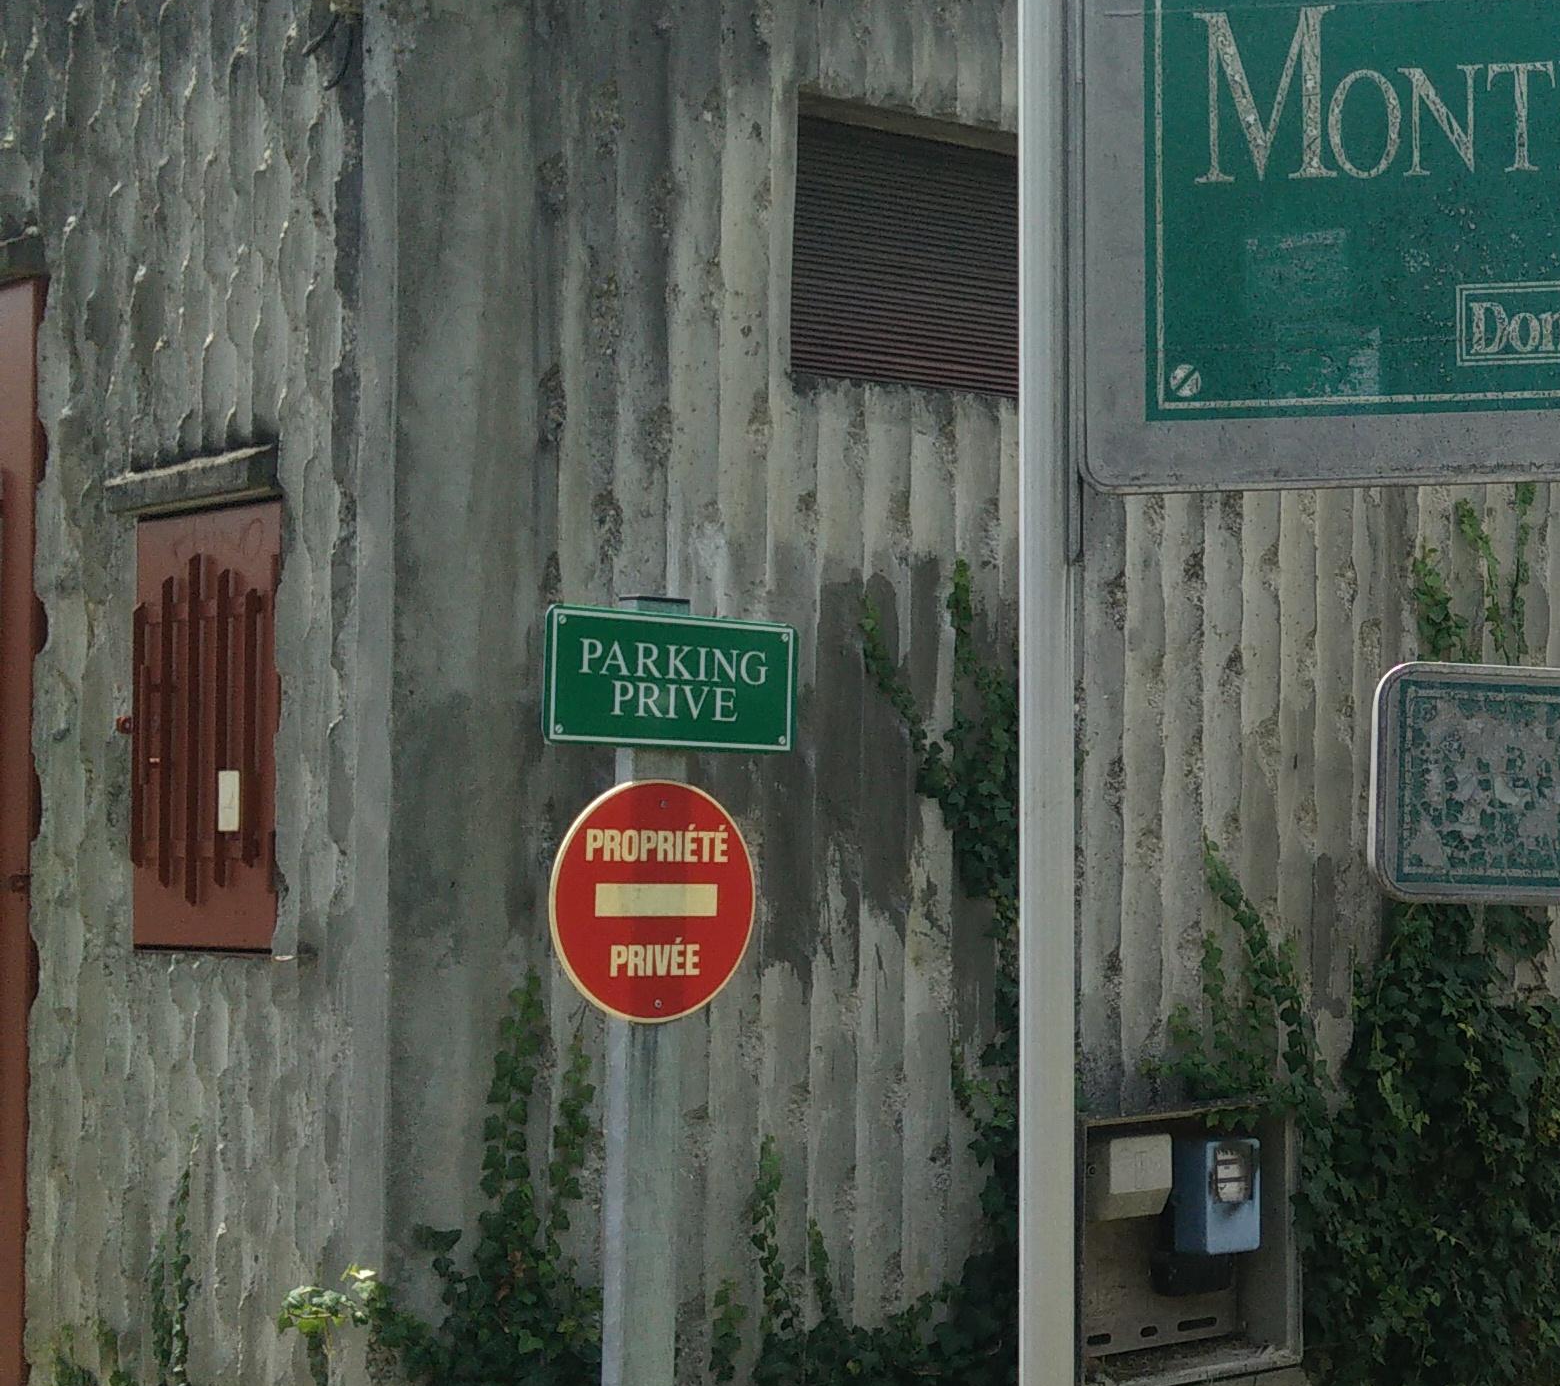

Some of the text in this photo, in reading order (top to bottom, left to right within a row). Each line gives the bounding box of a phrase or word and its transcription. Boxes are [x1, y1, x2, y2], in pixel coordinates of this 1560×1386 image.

[579, 637, 769, 686] PARKING
[610, 679, 739, 723] PRIVE
[585, 824, 729, 865] PROPRIÉTÉ
[609, 937, 701, 978] PRIVÉE
